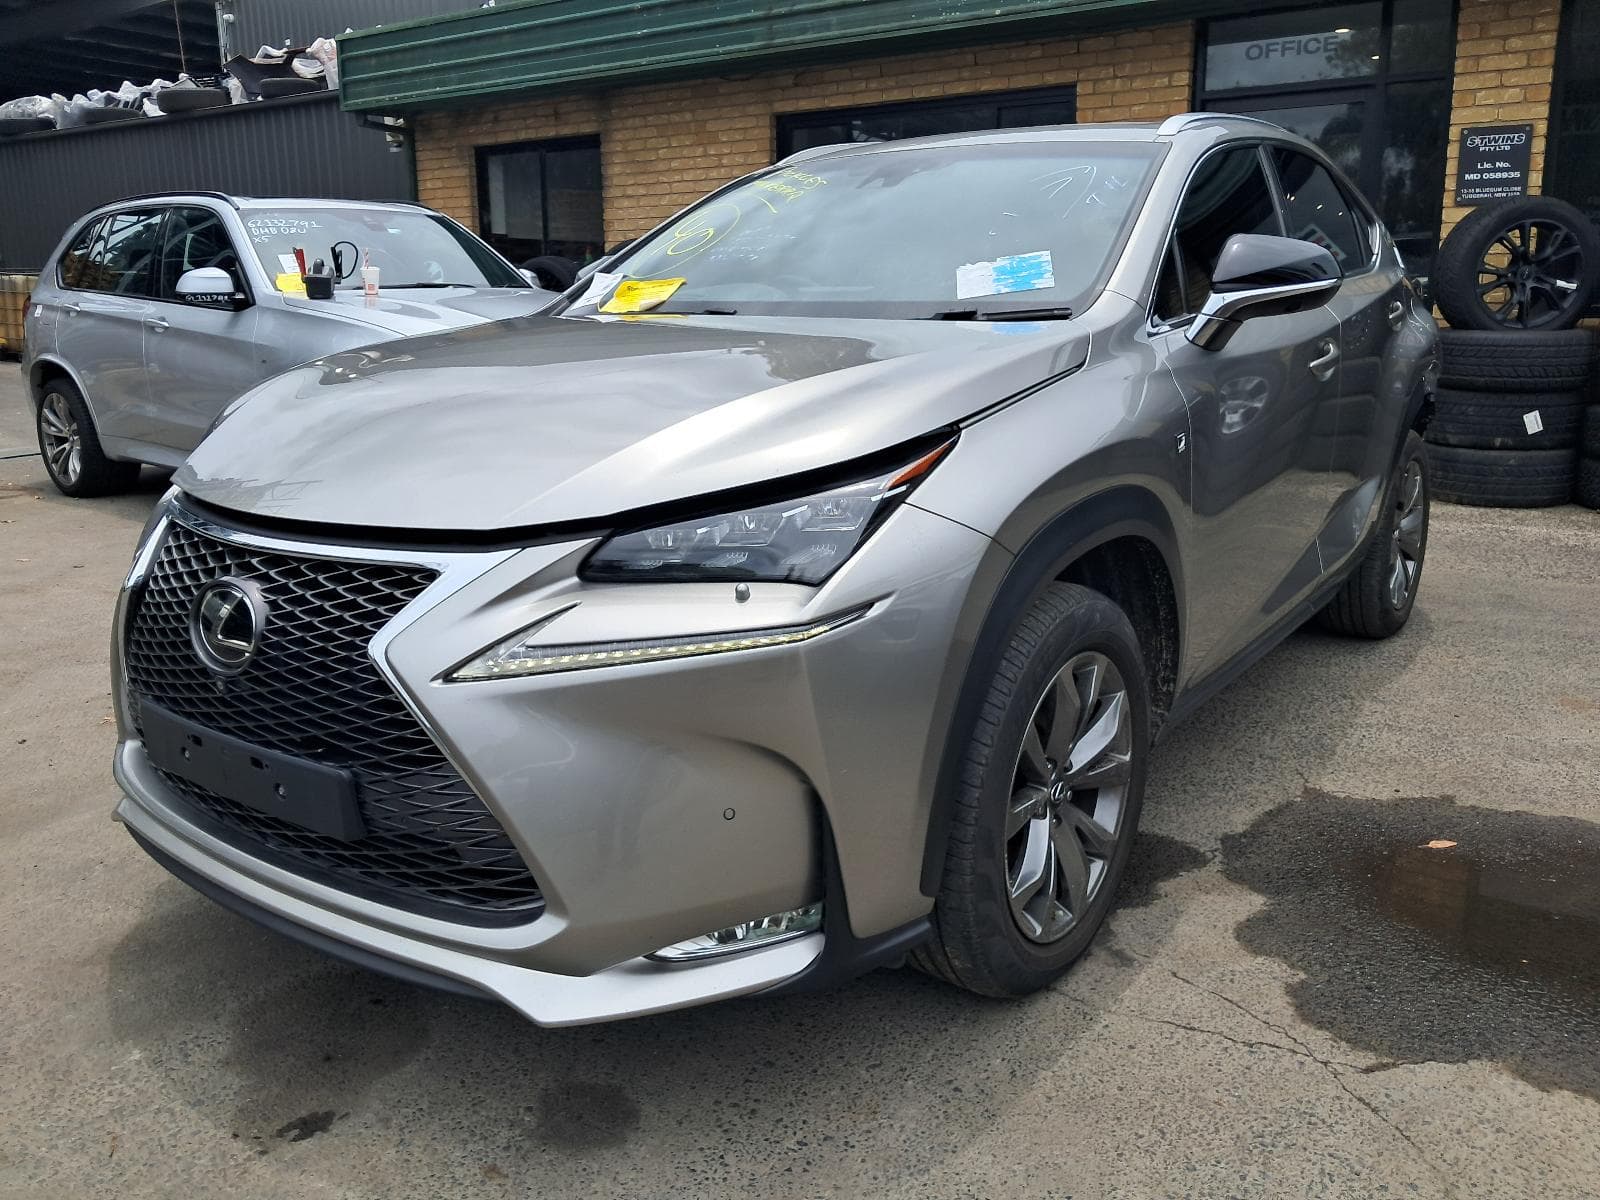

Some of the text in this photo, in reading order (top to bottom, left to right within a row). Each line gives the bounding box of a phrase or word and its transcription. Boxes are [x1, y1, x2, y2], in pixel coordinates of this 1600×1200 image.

[1245, 36, 1340, 61] OFFICE
[1464, 171, 1521, 181] MD 058935
